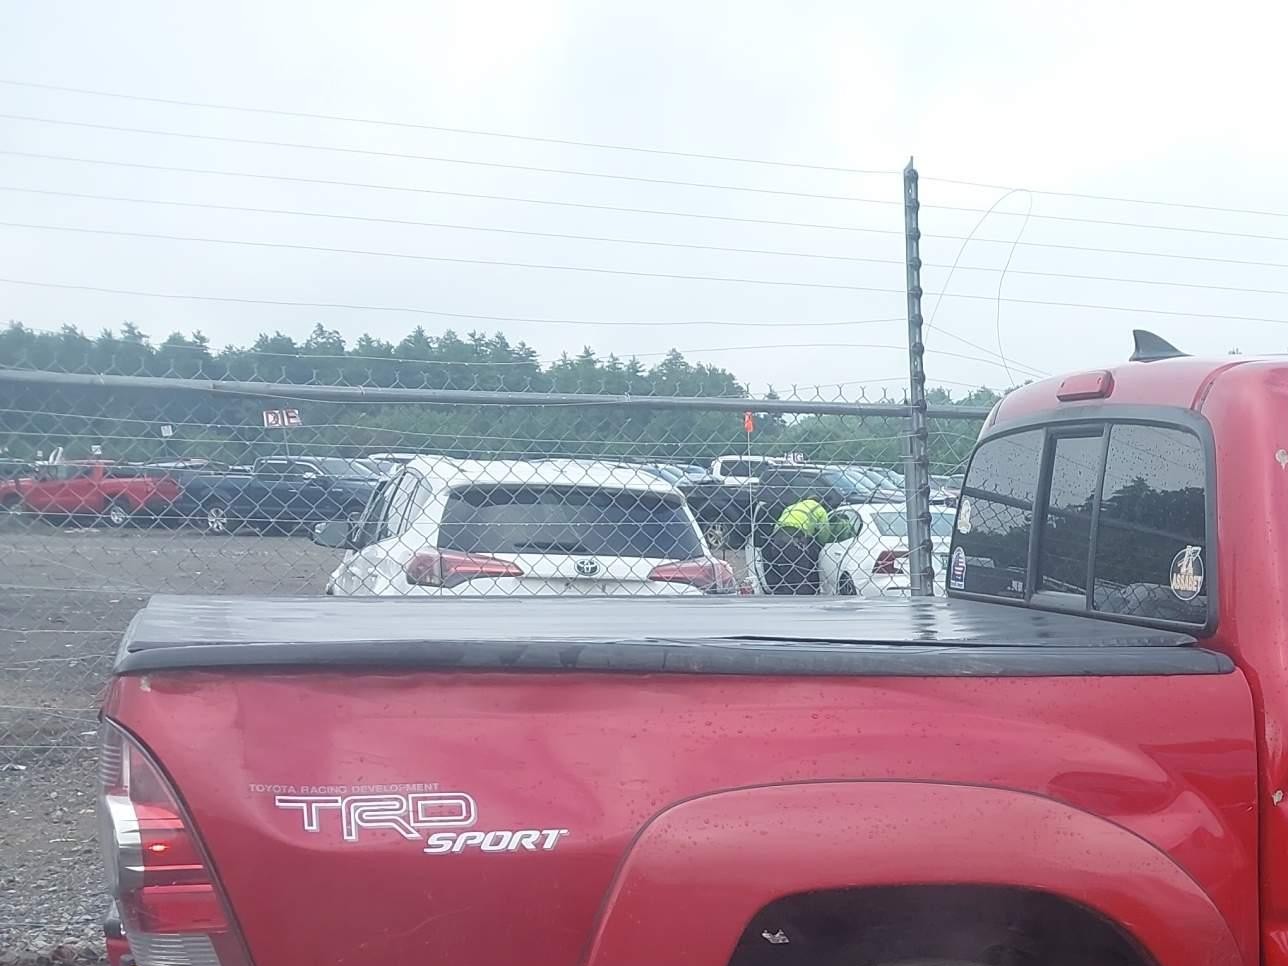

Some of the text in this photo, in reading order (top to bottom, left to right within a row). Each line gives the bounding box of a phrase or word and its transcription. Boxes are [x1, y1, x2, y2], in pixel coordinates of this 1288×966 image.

[249, 783, 440, 794] TOYOTA RACING DEVELOPMENT
[275, 792, 477, 841] TRD
[424, 829, 571, 855] SPORT
